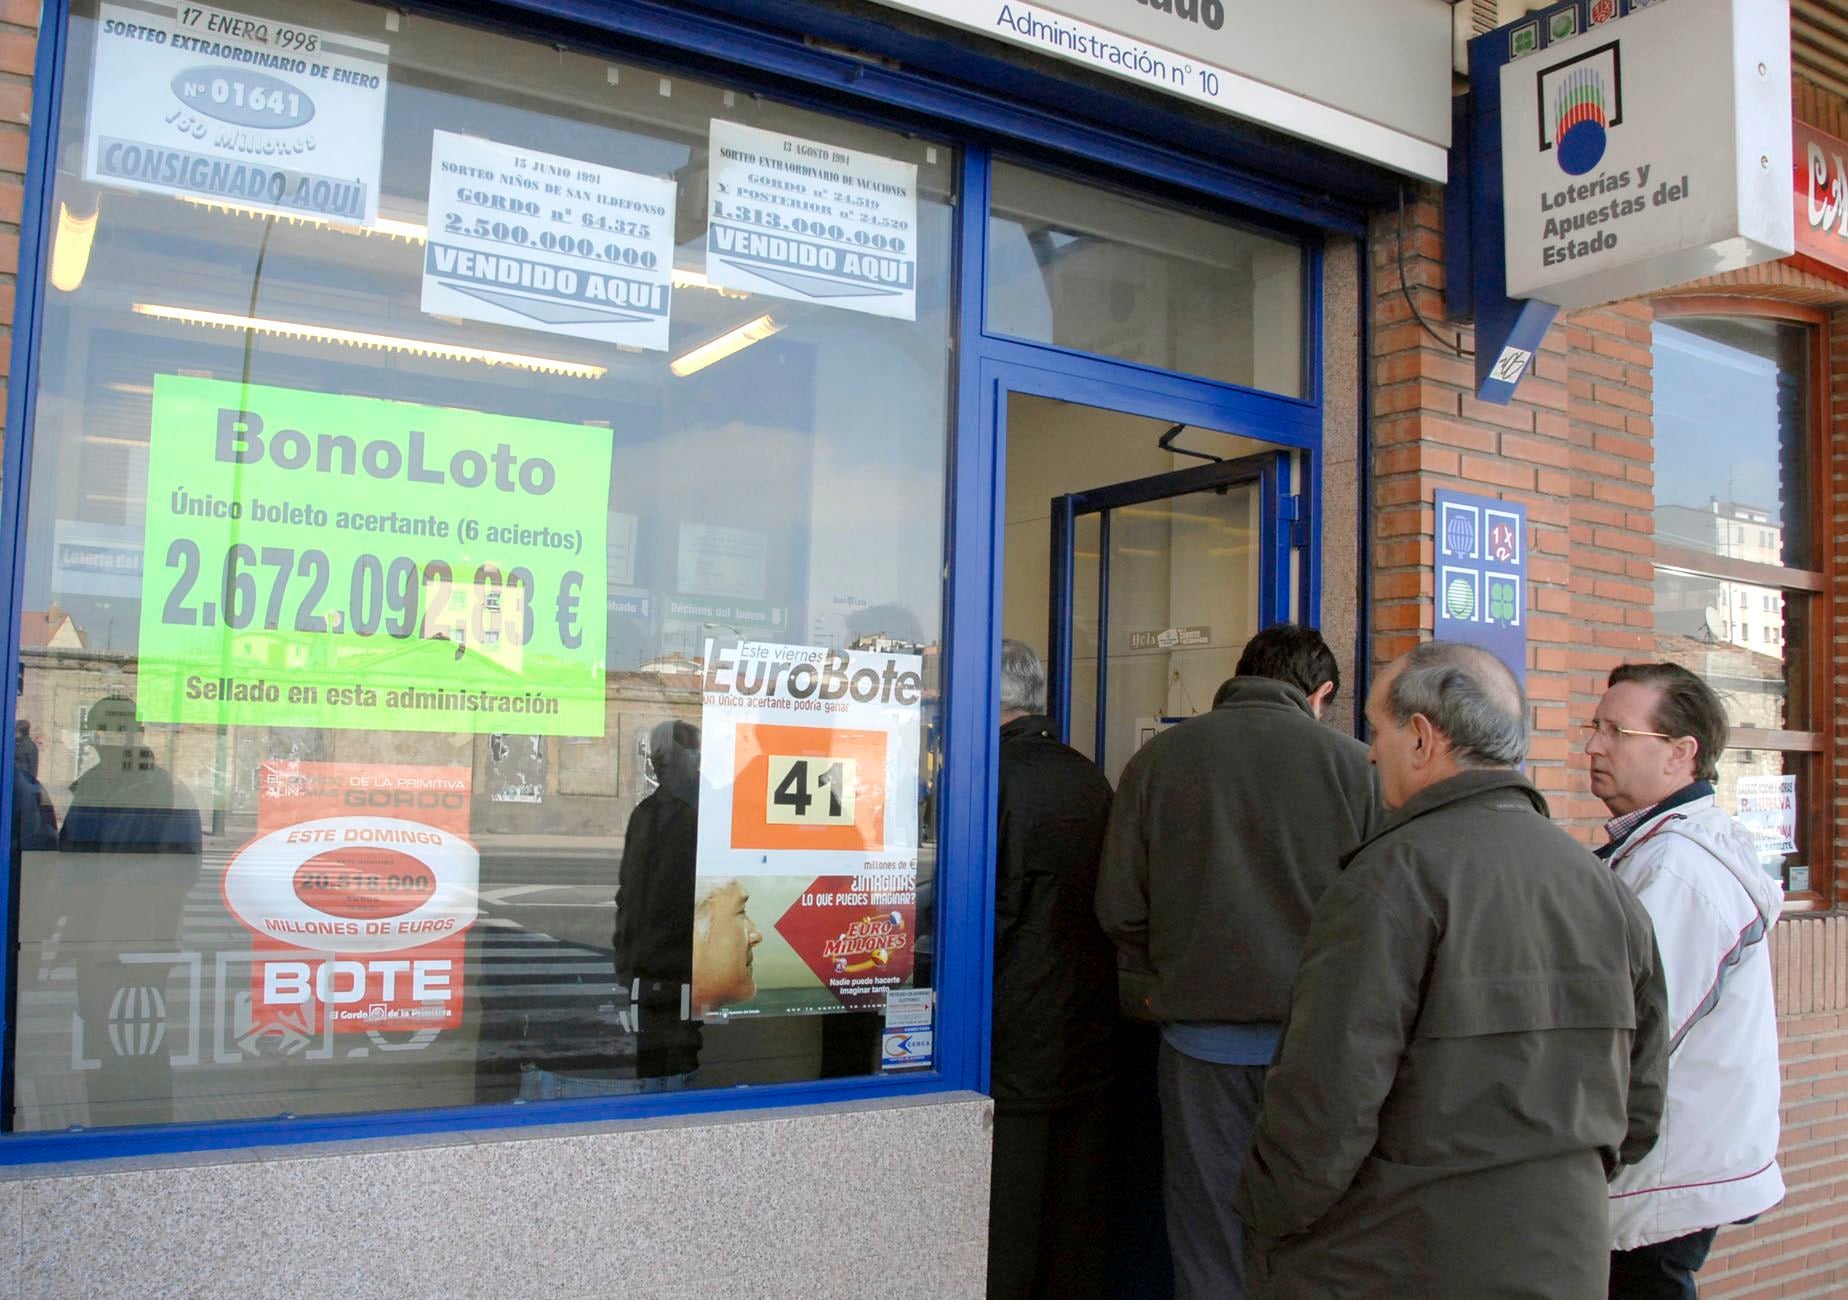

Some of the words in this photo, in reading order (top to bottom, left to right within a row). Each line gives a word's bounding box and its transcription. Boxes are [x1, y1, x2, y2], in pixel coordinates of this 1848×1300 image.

[182, 8, 202, 26] 17
[208, 13, 268, 44] ENERO
[274, 28, 318, 52] 1998
[103, 19, 167, 44] SORTEO
[171, 33, 306, 74] EXTRAORDINARIO
[310, 63, 329, 79] DE
[332, 68, 380, 89] ENERO
[996, 4, 1166, 79] Administración
[1199, 70, 1219, 96] 10
[212, 78, 299, 118] 01641
[214, 130, 316, 155] Millones
[783, 141, 792, 152] 13
[796, 145, 830, 161] AGOSTO
[104, 143, 286, 203] CONSIGNADO
[441, 160, 494, 181] SORTEO
[500, 173, 540, 191] NIÑOS
[545, 183, 562, 195] DE
[566, 187, 591, 201] SAN
[596, 194, 666, 217] ILDEFONSO
[514, 157, 527, 169] 15
[532, 161, 571, 179] JUNIO
[576, 170, 601, 185] 1991
[719, 147, 756, 164] SORTEO
[759, 156, 840, 183] EXTRAORDINARIO
[842, 174, 855, 186] DE
[856, 177, 907, 197] VACACIONES
[747, 173, 807, 194] GORDO
[1541, 170, 1630, 212] Loterías
[1637, 164, 1651, 188] y
[456, 187, 541, 216] GORDO
[581, 212, 651, 238] 64.375
[717, 182, 730, 194] Y
[736, 187, 832, 216] POSTERIOR
[1543, 195, 1646, 240] Apuestas
[1652, 175, 1689, 206] del
[444, 212, 658, 269] 2.500.000.000
[712, 200, 906, 251] 1.313.000.000
[714, 225, 836, 271] VENDIDO
[1543, 230, 1617, 267] Estado
[433, 245, 577, 295] VENDIDO
[214, 407, 556, 497] BonoLoto
[171, 485, 242, 520] Único
[252, 498, 328, 528] boleto
[336, 510, 450, 539] acertante
[457, 518, 479, 545] (6
[486, 523, 584, 556] aciertos)
[161, 537, 535, 662] 2.672.092,83
[555, 570, 584, 650] €
[670, 601, 713, 617] Décimos
[716, 606, 730, 618] del
[704, 637, 921, 706] EuroBote
[740, 642, 769, 659] Este
[774, 646, 823, 663] viernes
[185, 674, 281, 705] Sellado
[288, 684, 318, 706] en
[326, 683, 377, 708] esta
[384, 686, 559, 715] administración
[718, 693, 744, 707] único
[747, 697, 791, 709] acertante
[794, 696, 821, 711] podría
[824, 703, 849, 713] ganar
[344, 791, 464, 809] GORDO
[350, 777, 369, 787] DE
[375, 777, 392, 787] LA
[397, 777, 465, 789] PRIMITIVA
[773, 759, 843, 818] 41
[286, 828, 337, 844] ESTE
[343, 828, 443, 846] DOMINGO
[851, 875, 916, 892] ¿IMAGINAS
[864, 860, 896, 870] millones
[898, 860, 907, 870] de
[802, 893, 814, 906] LO
[816, 893, 833, 907] QUE
[835, 893, 868, 906] PUEDES
[871, 893, 916, 905] IMAGINAR?
[264, 918, 359, 936] MILLONES
[365, 923, 391, 936] DE
[398, 918, 455, 934] EUROS
[822, 933, 907, 958] MILLONES
[847, 921, 893, 939] EURO
[263, 959, 452, 1005] BOTE
[829, 978, 850, 987] Nadie
[852, 977, 873, 987] puede
[874, 976, 900, 984] hacerte
[872, 986, 890, 994] tanto
[341, 1009, 368, 1019] Gordo
[388, 1009, 399, 1018] de
[401, 1008, 410, 1017] la
[412, 1008, 452, 1017] Primitiva
